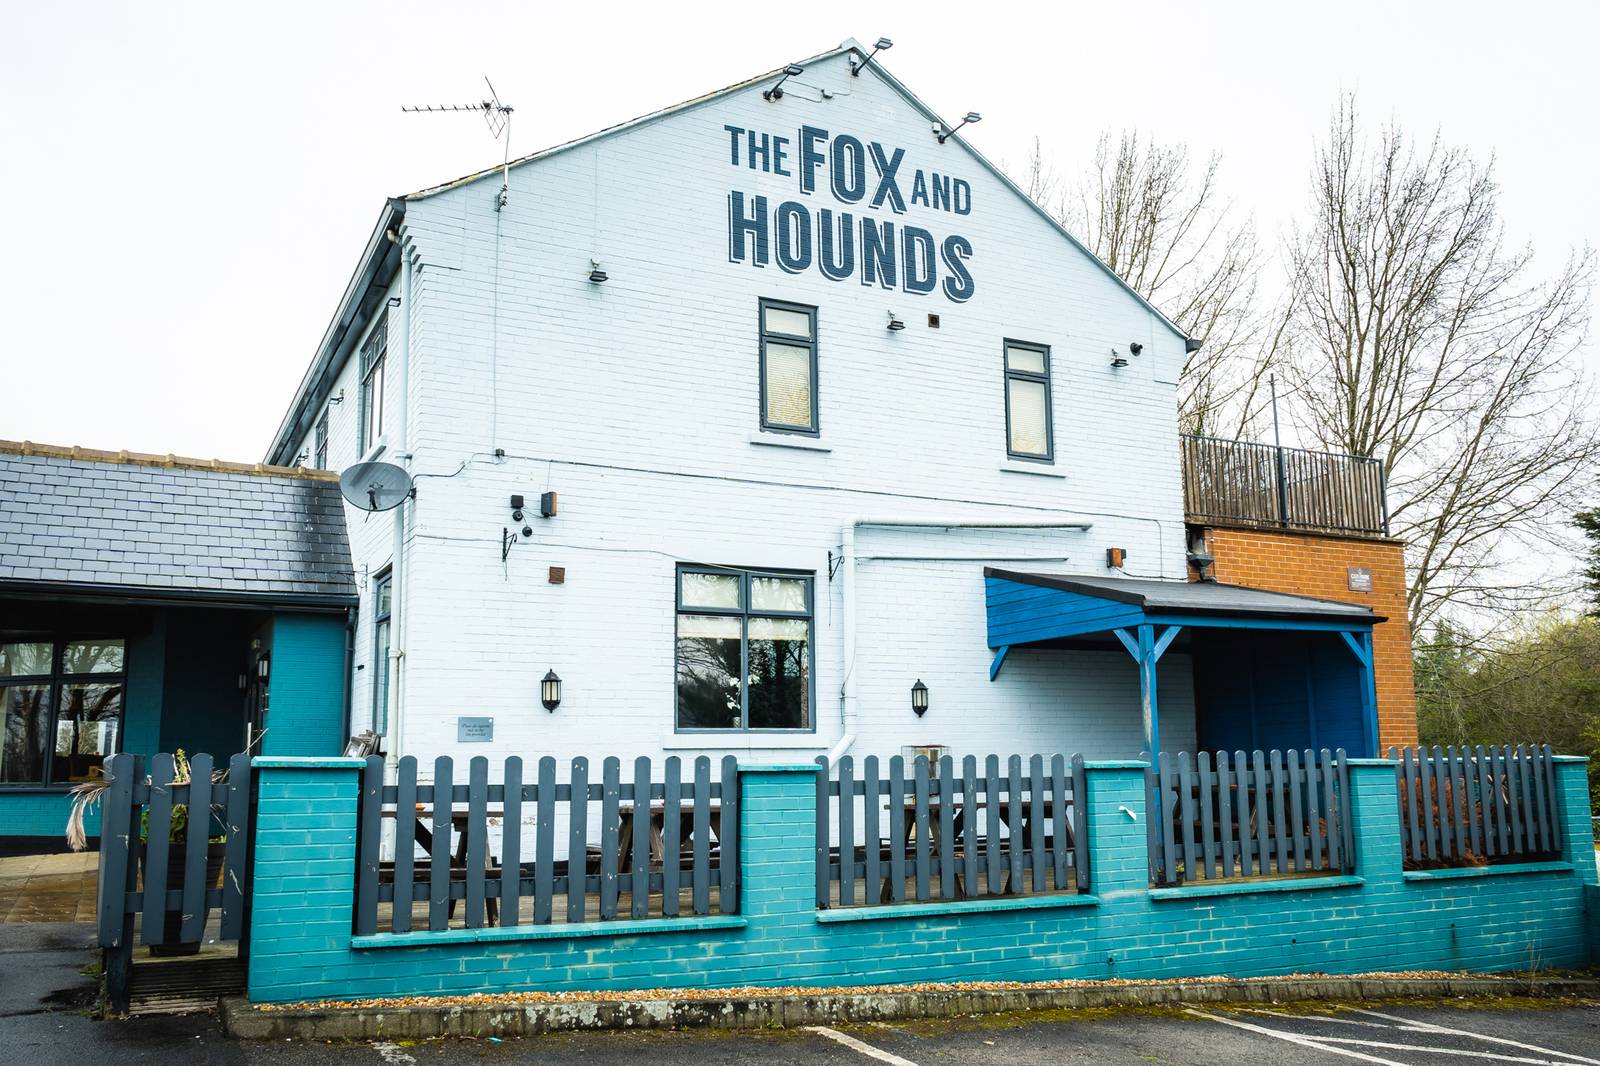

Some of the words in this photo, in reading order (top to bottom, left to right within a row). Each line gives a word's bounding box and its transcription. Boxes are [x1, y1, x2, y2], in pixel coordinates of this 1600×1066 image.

[724, 124, 791, 177] THE
[798, 124, 907, 215] FOX
[911, 169, 971, 216] AND
[727, 190, 975, 303] HOUNDS
